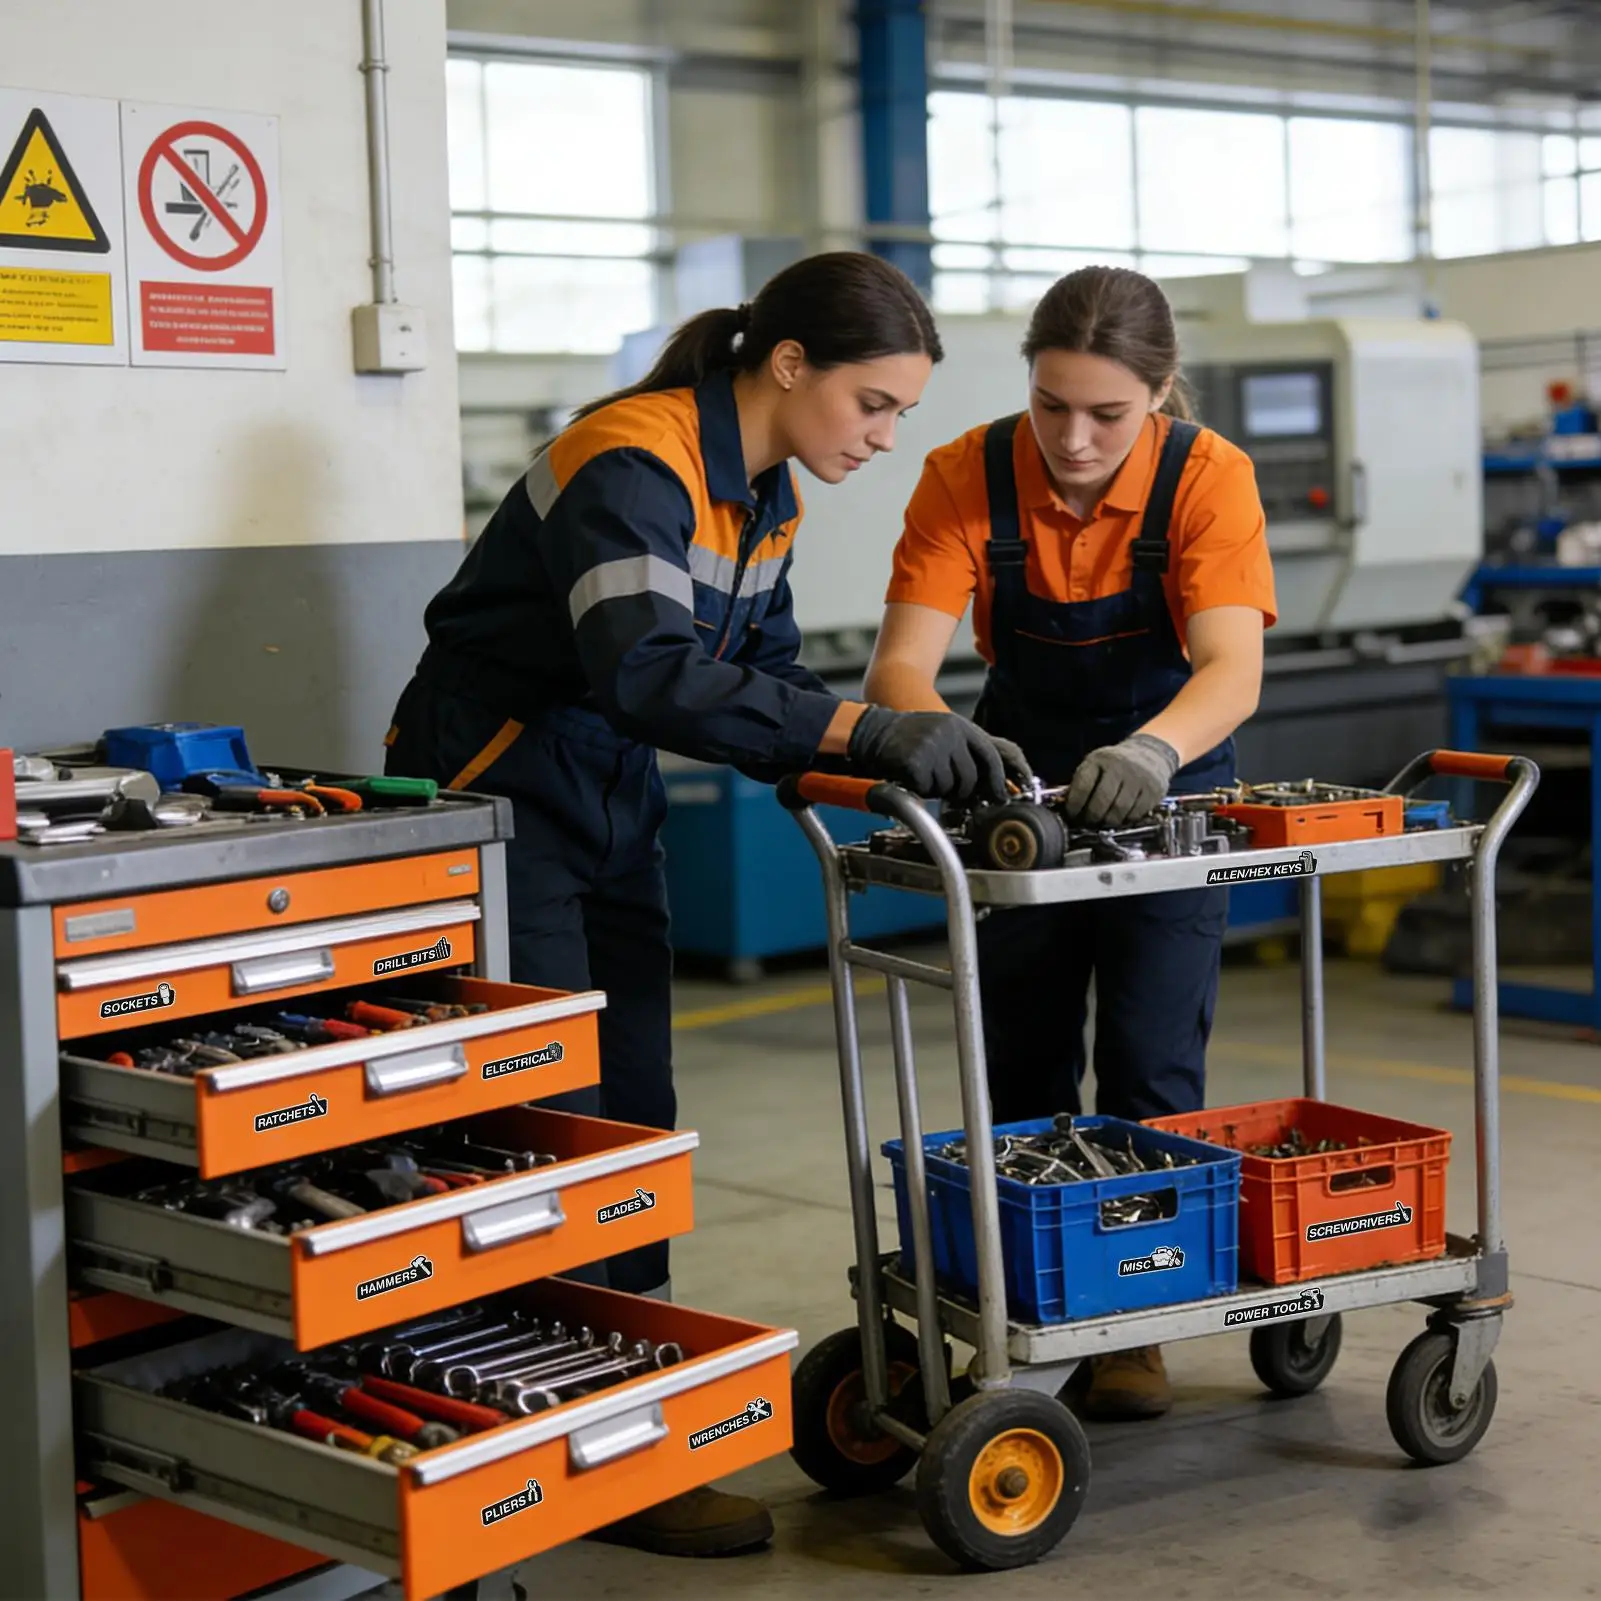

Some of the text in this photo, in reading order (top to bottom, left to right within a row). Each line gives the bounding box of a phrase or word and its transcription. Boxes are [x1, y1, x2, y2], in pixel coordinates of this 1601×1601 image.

[1209, 863, 1303, 882] ALLEN/HEX KEYS
[377, 950, 436, 972] DRILL BITS
[103, 996, 158, 1015] SOCKETS
[485, 1051, 553, 1076] ELECTRICAL
[258, 1106, 316, 1129] RATCHETS
[600, 1200, 642, 1221] BLADES
[1309, 1213, 1401, 1238] SCREWDRIVERS
[1122, 1260, 1152, 1273] MISC
[360, 1269, 417, 1296] HAMMERS
[1227, 1300, 1312, 1324] POWER TOOLS
[691, 1415, 750, 1446] WRENCHES
[484, 1496, 527, 1522] PLIERS
